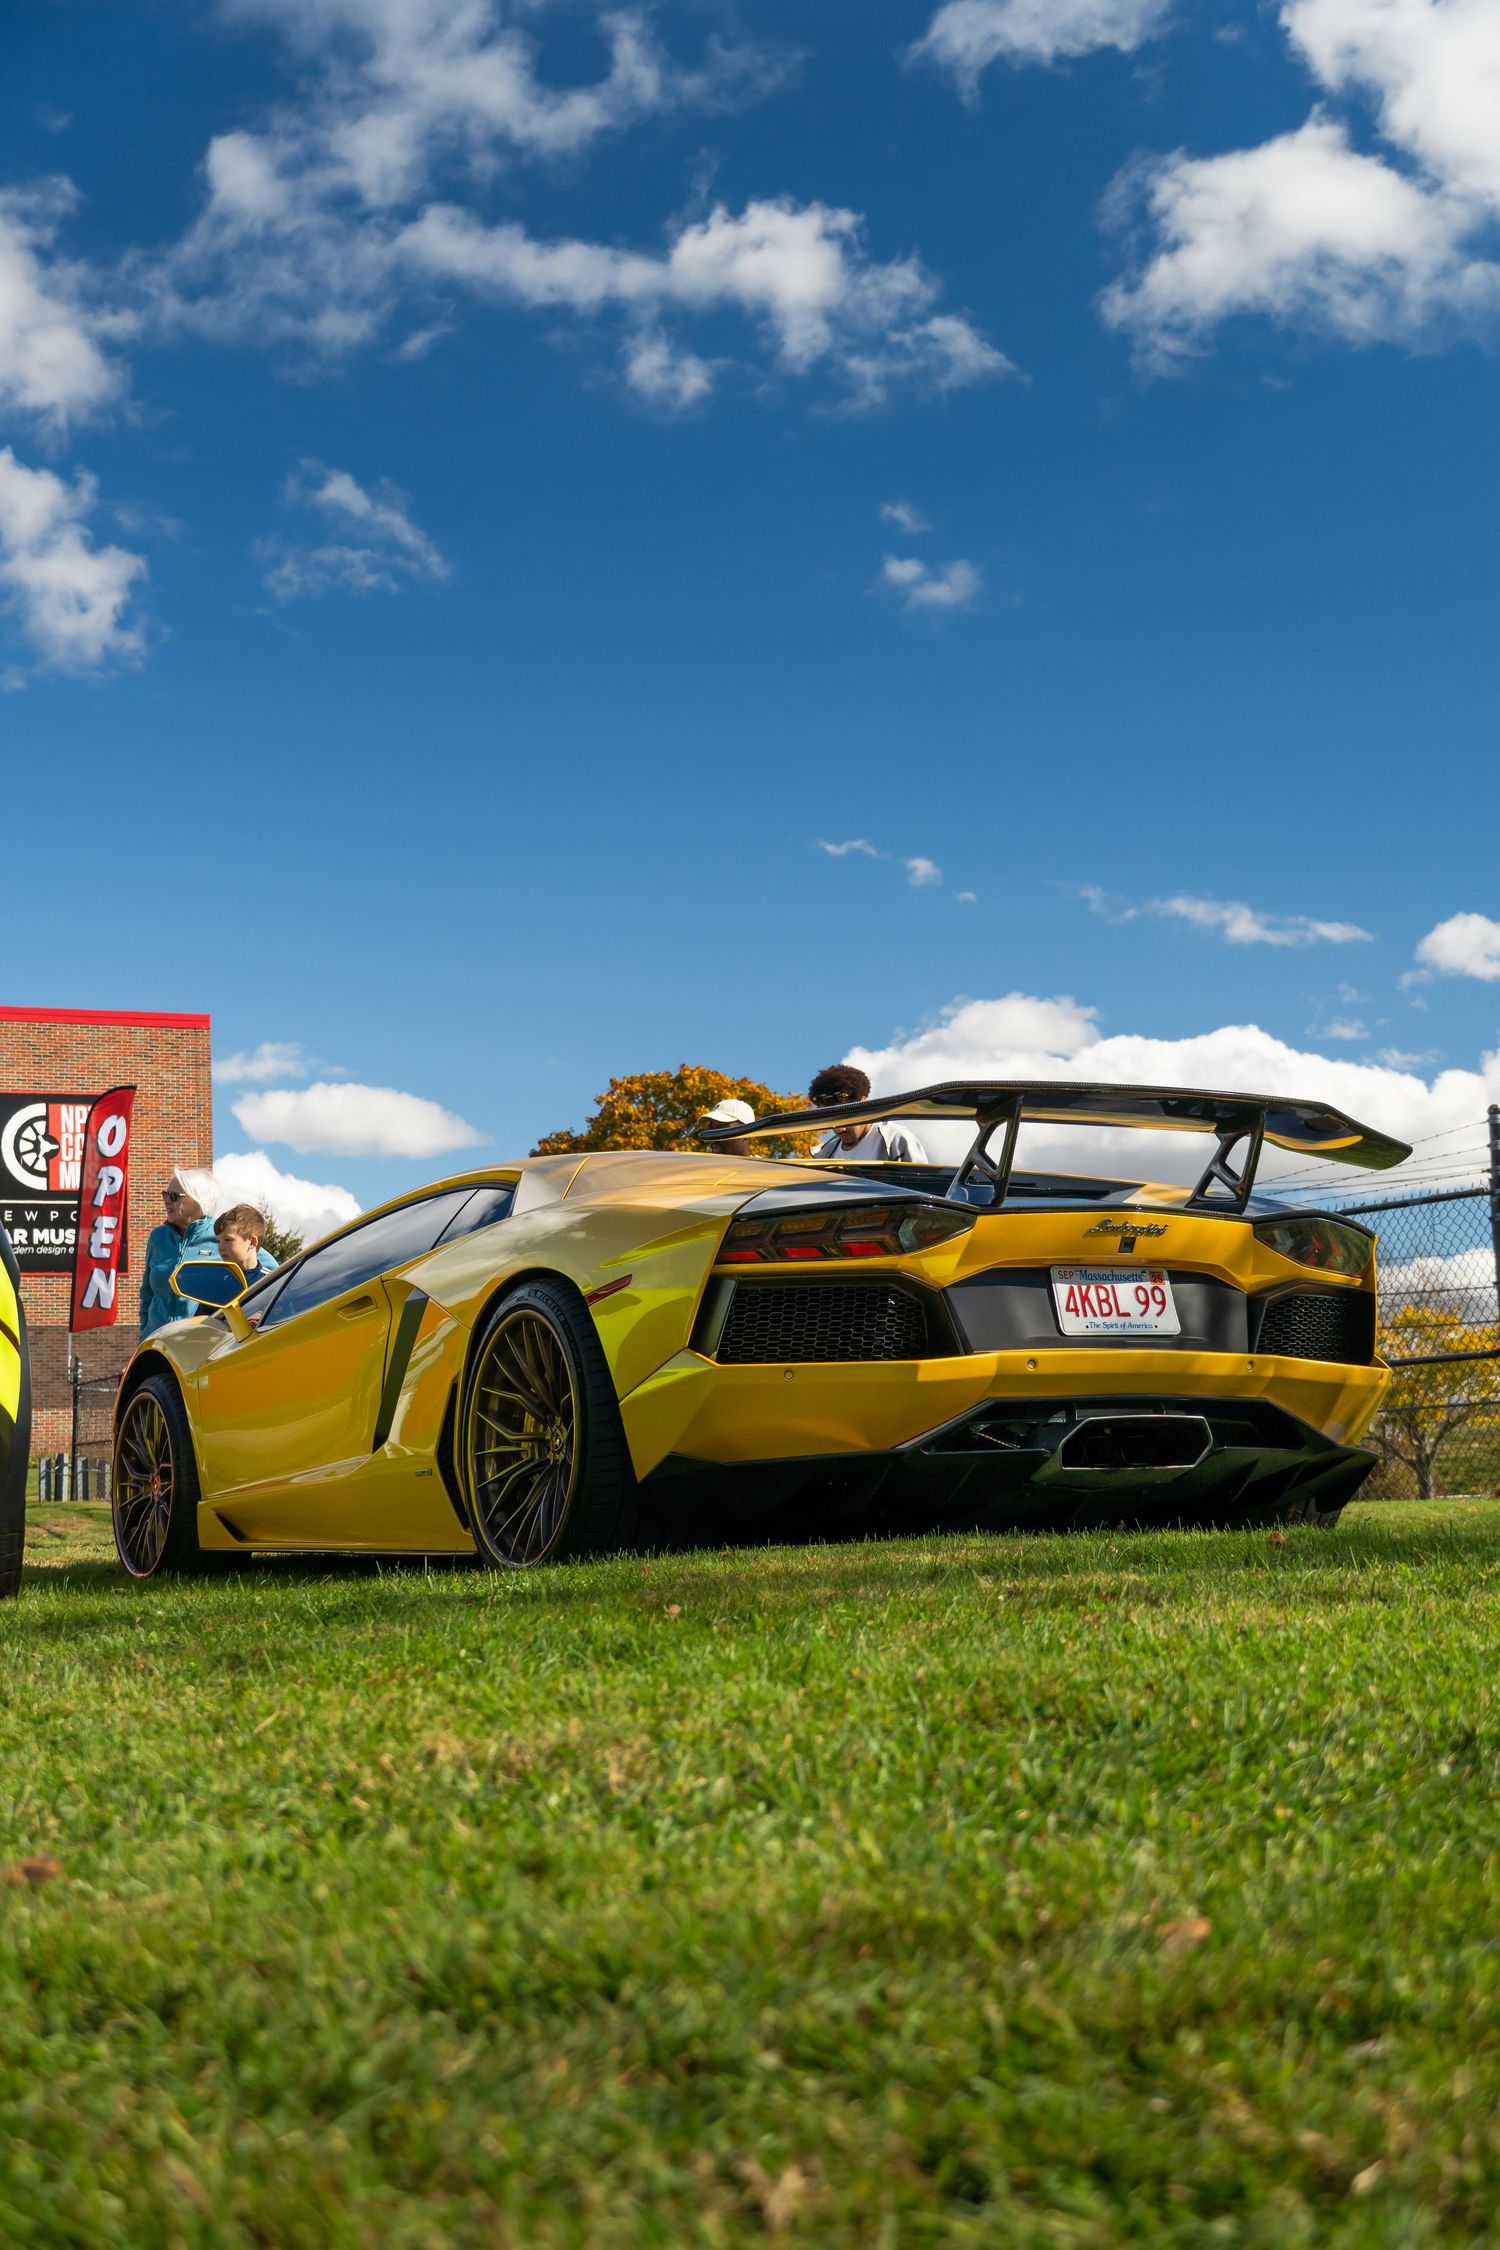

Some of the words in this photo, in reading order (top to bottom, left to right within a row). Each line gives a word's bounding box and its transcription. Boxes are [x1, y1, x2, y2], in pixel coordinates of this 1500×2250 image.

[60, 1104, 92, 1133] NP
[82, 1114, 127, 1309] OPEN
[32, 1228, 76, 1245] MUS
[36, 1245, 67, 1256] design
[1058, 1270, 1075, 1280] SEP
[1079, 1269, 1143, 1283] Massachusetts
[1065, 1284, 1131, 1318] 4KBL
[1134, 1285, 1167, 1318] 99
[1089, 1321, 1101, 1329] The
[1102, 1321, 1119, 1331] Spirit
[1120, 1321, 1127, 1331] of
[1128, 1321, 1154, 1330] America
